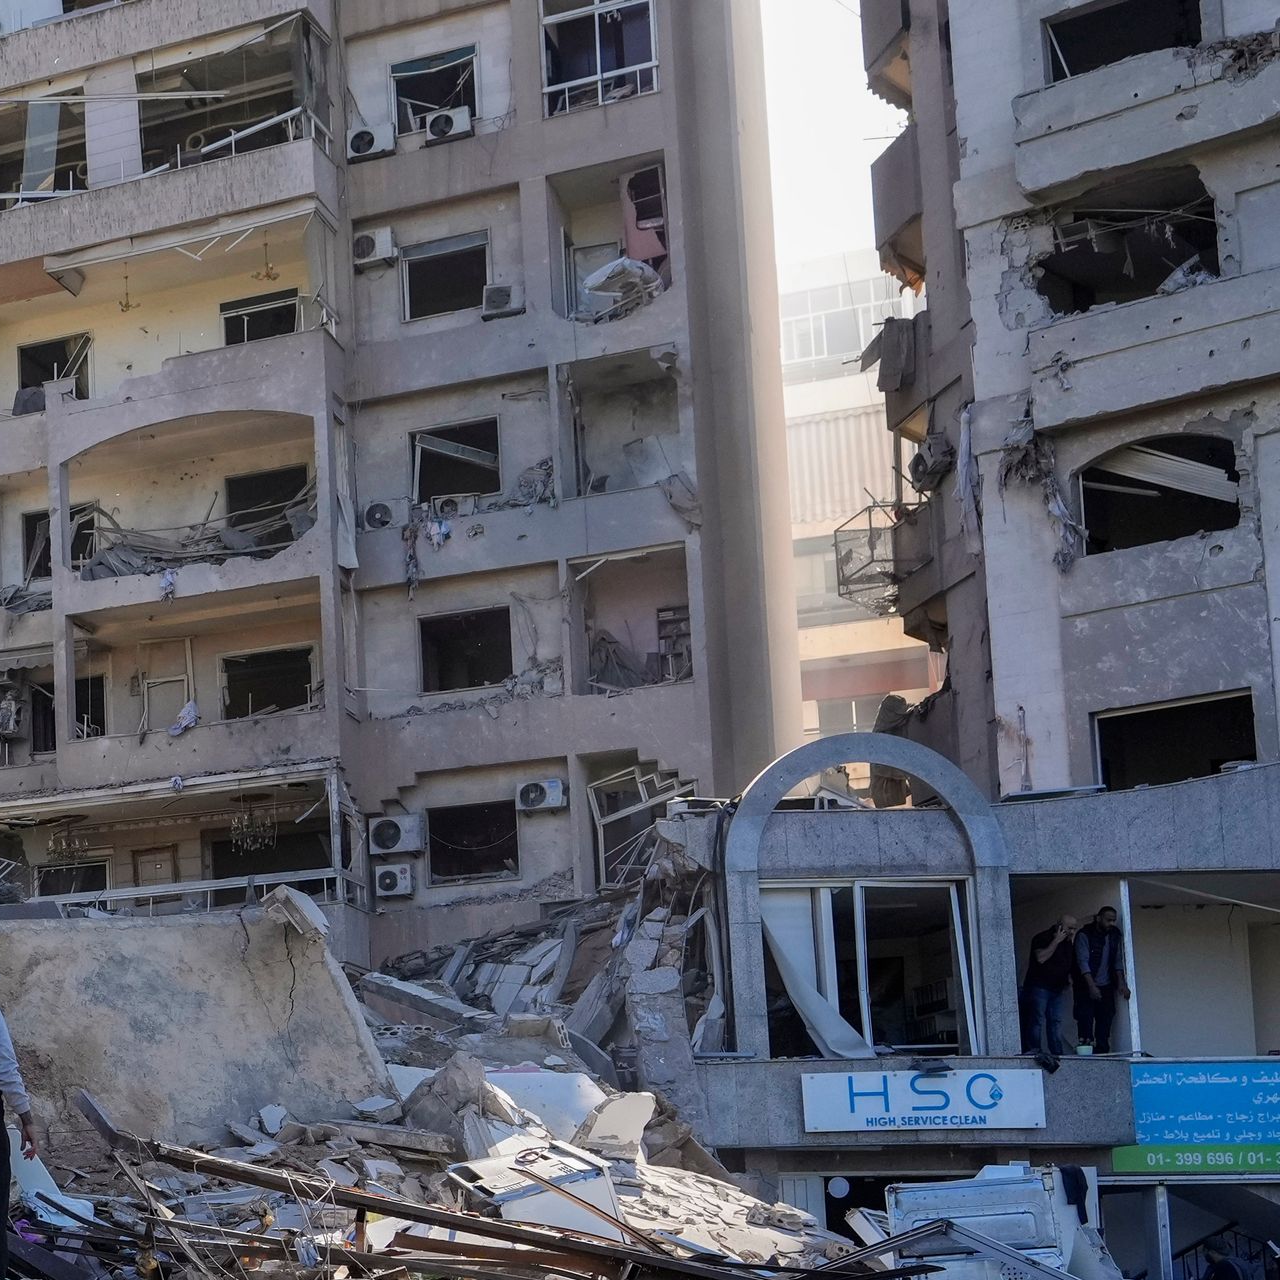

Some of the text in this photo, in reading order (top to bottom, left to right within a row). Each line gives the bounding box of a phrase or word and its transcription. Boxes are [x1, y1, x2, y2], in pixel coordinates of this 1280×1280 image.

[1132, 1072, 1172, 1088] الحشر
[1176, 1072, 1238, 1086] مكافحة
[1240, 1075, 1248, 1087] و
[1252, 1092, 1280, 1105] هري
[866, 1115, 987, 1127] HIGH SERVICE CLEAN
[1139, 1112, 1166, 1124] منازل
[1178, 1111, 1214, 1124] مطاعم
[1225, 1111, 1254, 1124] زجاج
[1136, 1131, 1150, 1142] رخ
[1163, 1129, 1189, 1142] بلاط
[1192, 1129, 1221, 1143] تلميع
[1147, 1153, 1171, 1166] 01-
[1175, 1152, 1202, 1165] 399
[1207, 1152, 1234, 1165] 696
[1247, 1151, 1272, 1165] 01-
